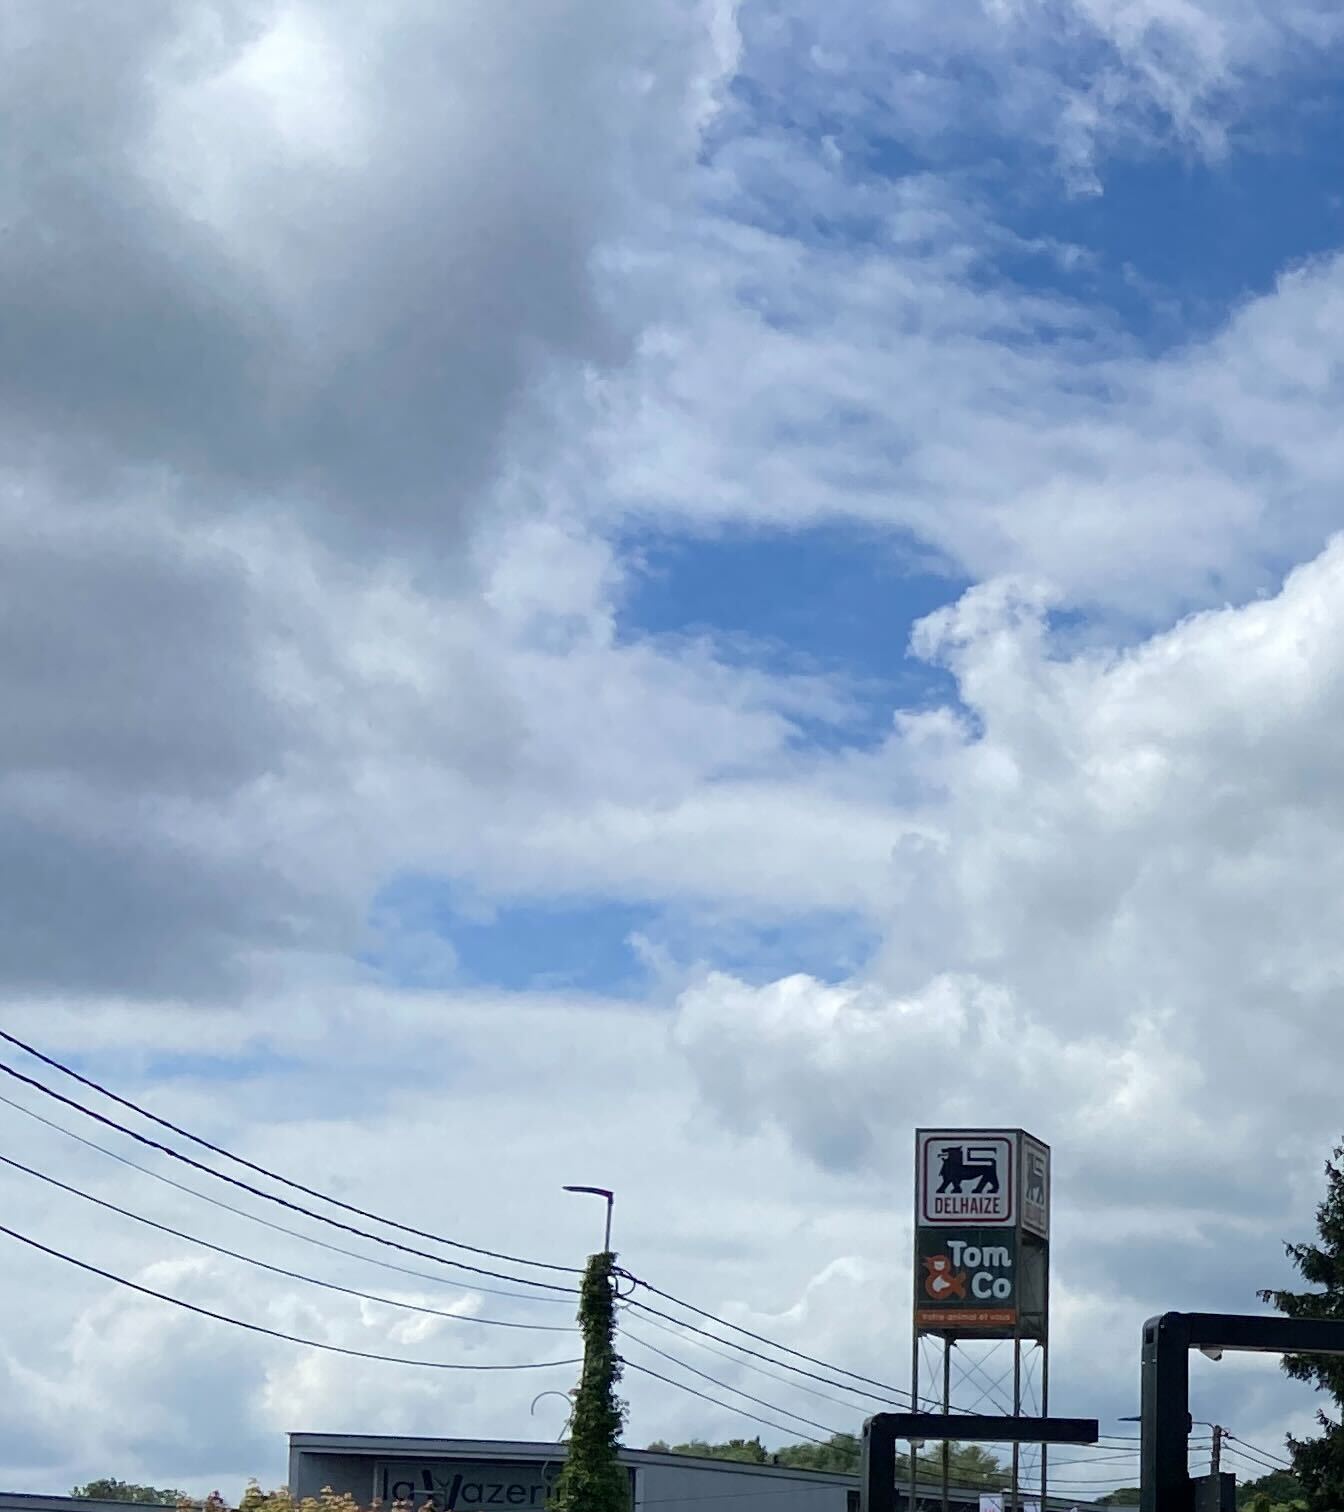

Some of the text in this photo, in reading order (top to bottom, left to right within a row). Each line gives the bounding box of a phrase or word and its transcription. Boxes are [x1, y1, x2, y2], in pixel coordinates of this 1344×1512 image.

[935, 1197, 1000, 1214] DELHAIZE
[947, 1240, 1012, 1267] Tom
[971, 1271, 1011, 1299] Co
